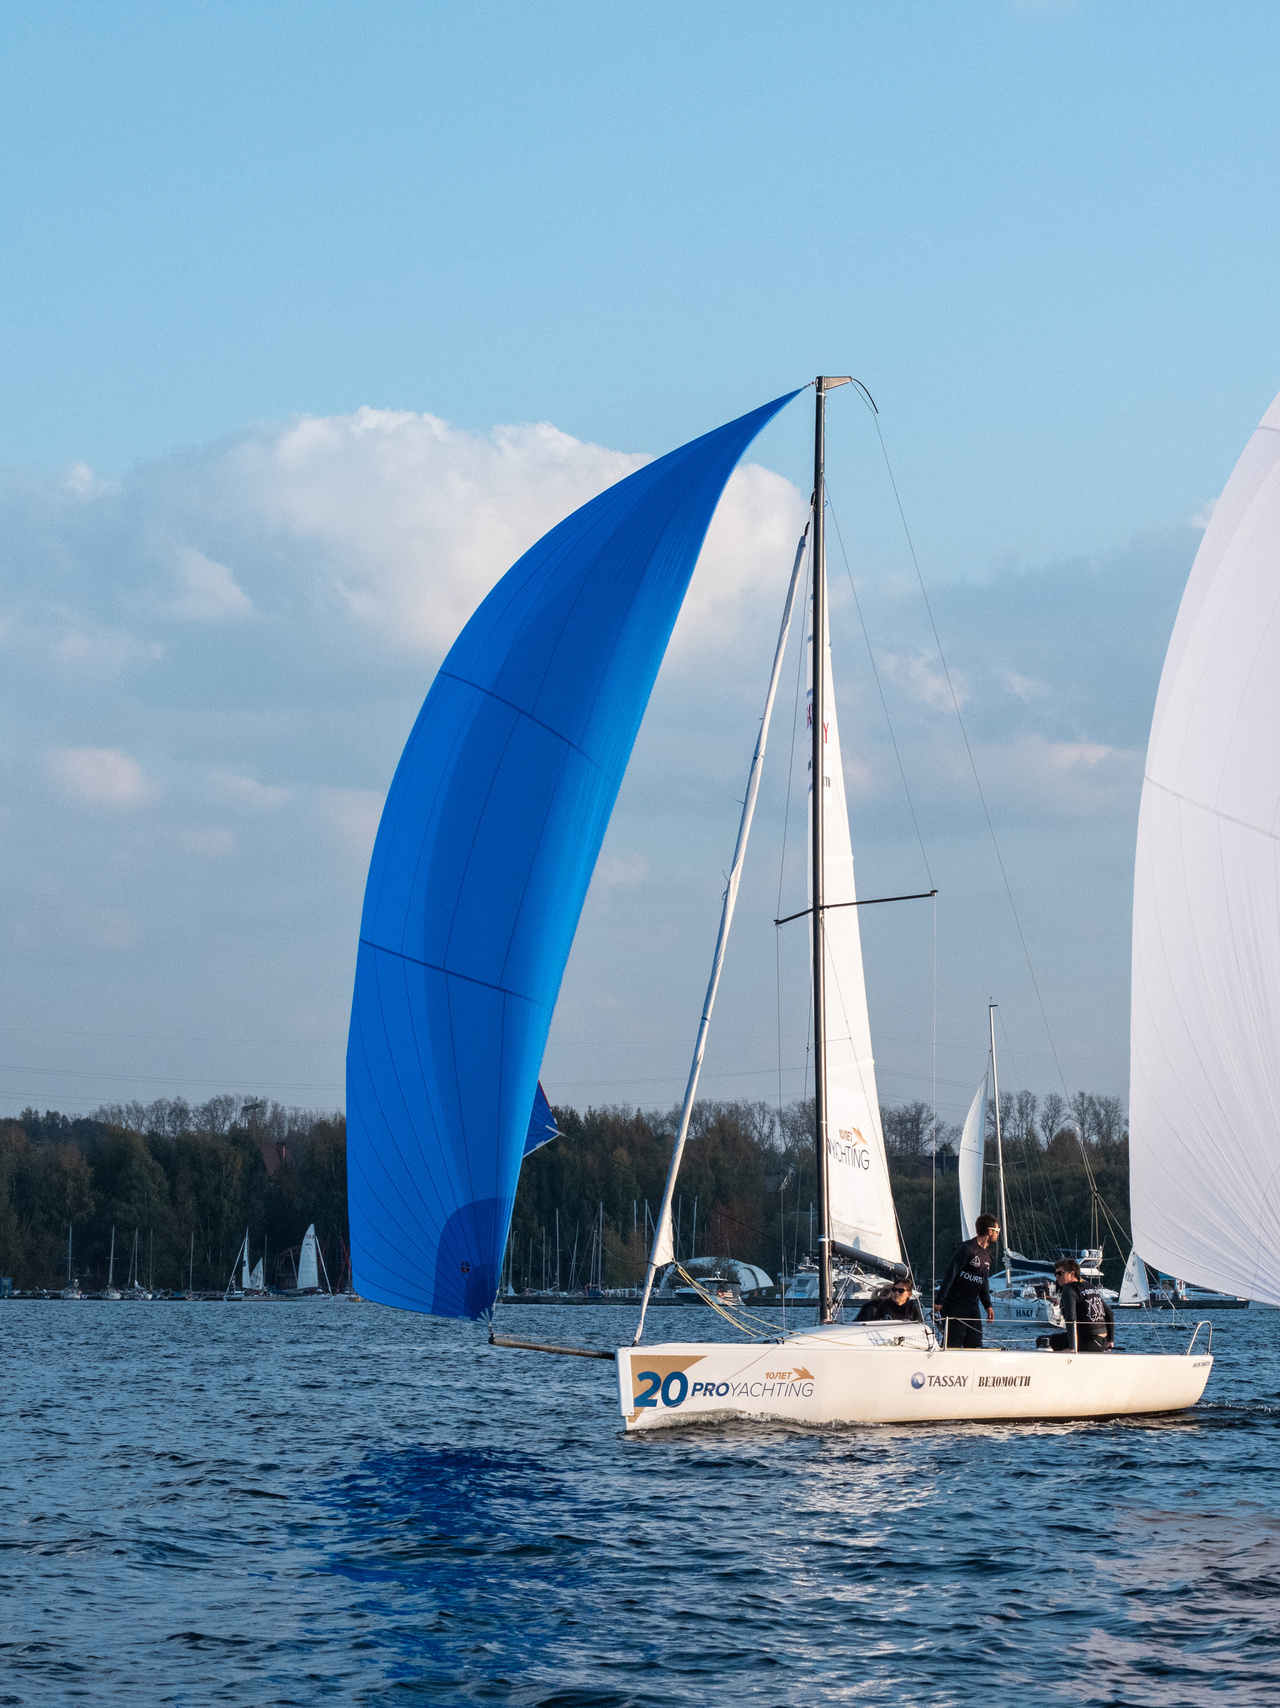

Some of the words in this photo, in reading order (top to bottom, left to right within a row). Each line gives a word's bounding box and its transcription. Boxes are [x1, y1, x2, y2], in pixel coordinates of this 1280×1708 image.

[633, 1370, 689, 1408] 20
[927, 1375, 969, 1387] TASSAY
[978, 1375, 1031, 1388] ВЕДОМОСТИ
[691, 1382, 815, 1398] PROYACHTING
